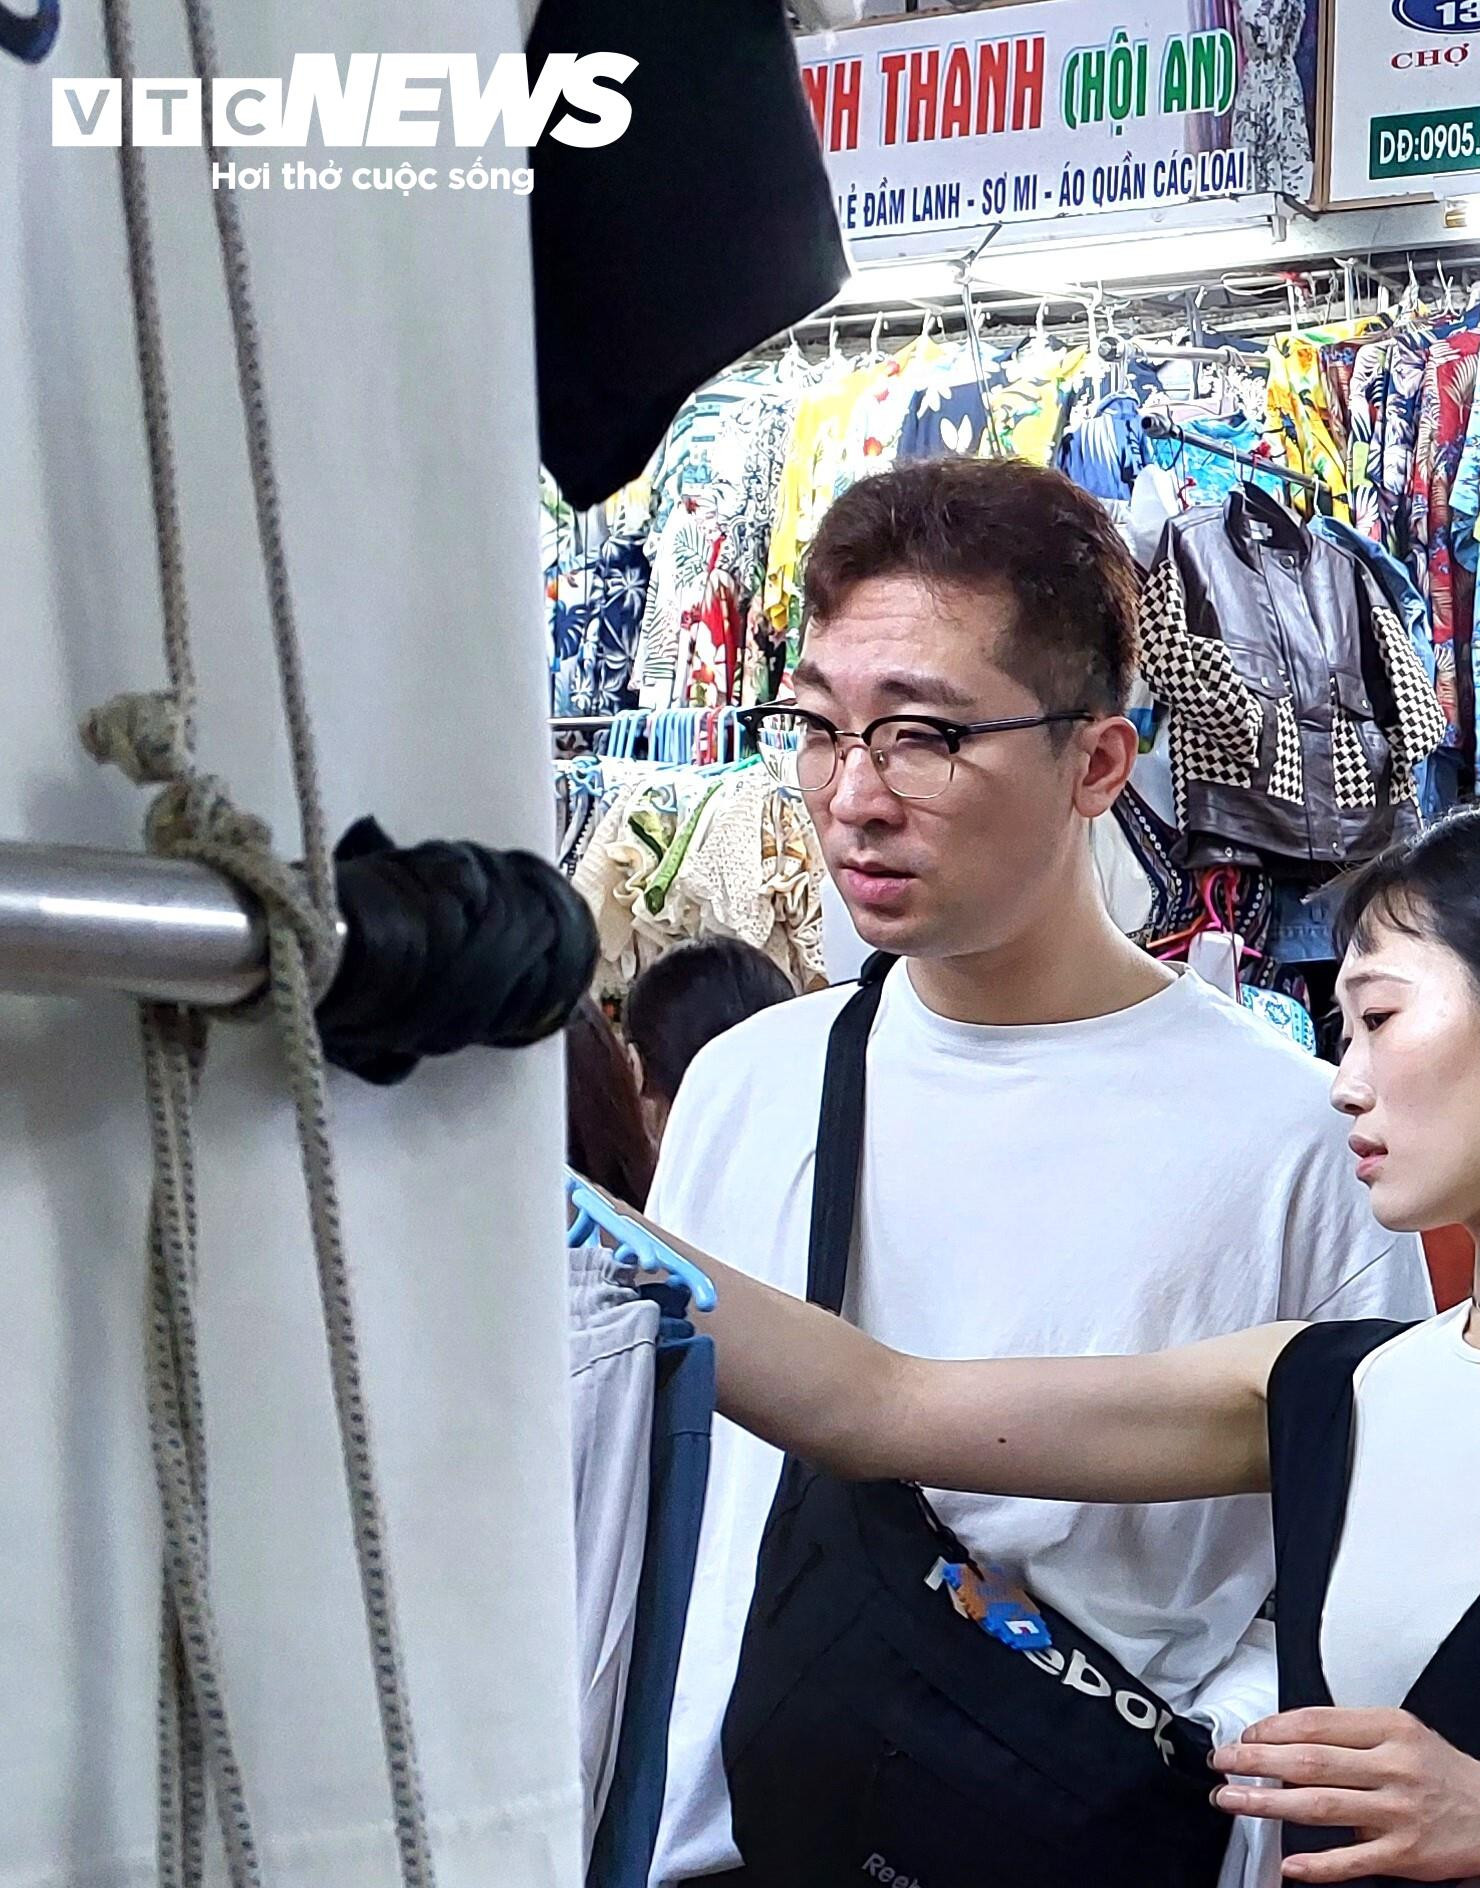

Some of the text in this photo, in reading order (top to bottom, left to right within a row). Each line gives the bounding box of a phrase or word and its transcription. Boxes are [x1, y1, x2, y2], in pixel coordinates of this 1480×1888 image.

[881, 37, 1045, 145] THANH
[1064, 32, 1147, 135] (HỘI
[1163, 33, 1236, 113] AN)
[1391, 43, 1469, 69] CHỢ
[864, 177, 905, 227] ĐẦM
[912, 183, 960, 222] LANH
[1014, 175, 1037, 212] MI
[1059, 161, 1085, 207] ÁO
[1093, 150, 1146, 207] QUẦN
[1154, 150, 1193, 197] CÁC
